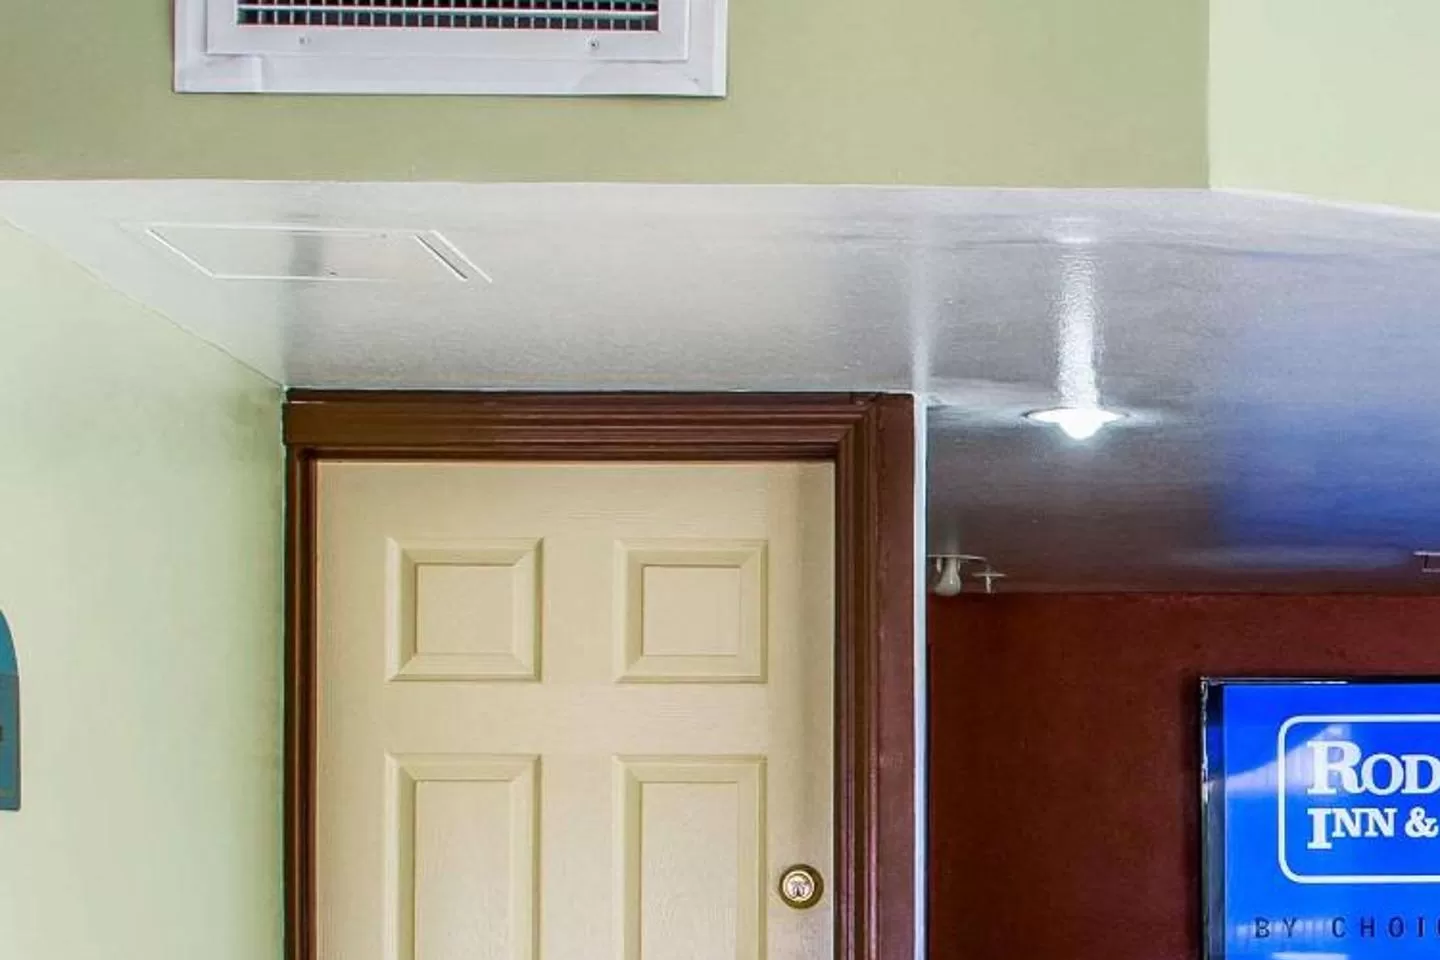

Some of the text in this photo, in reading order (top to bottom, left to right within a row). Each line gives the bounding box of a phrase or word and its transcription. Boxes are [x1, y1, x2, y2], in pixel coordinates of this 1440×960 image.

[1306, 807, 1398, 849] INN
[1404, 806, 1439, 838] &
[1254, 916, 1297, 939] BY
